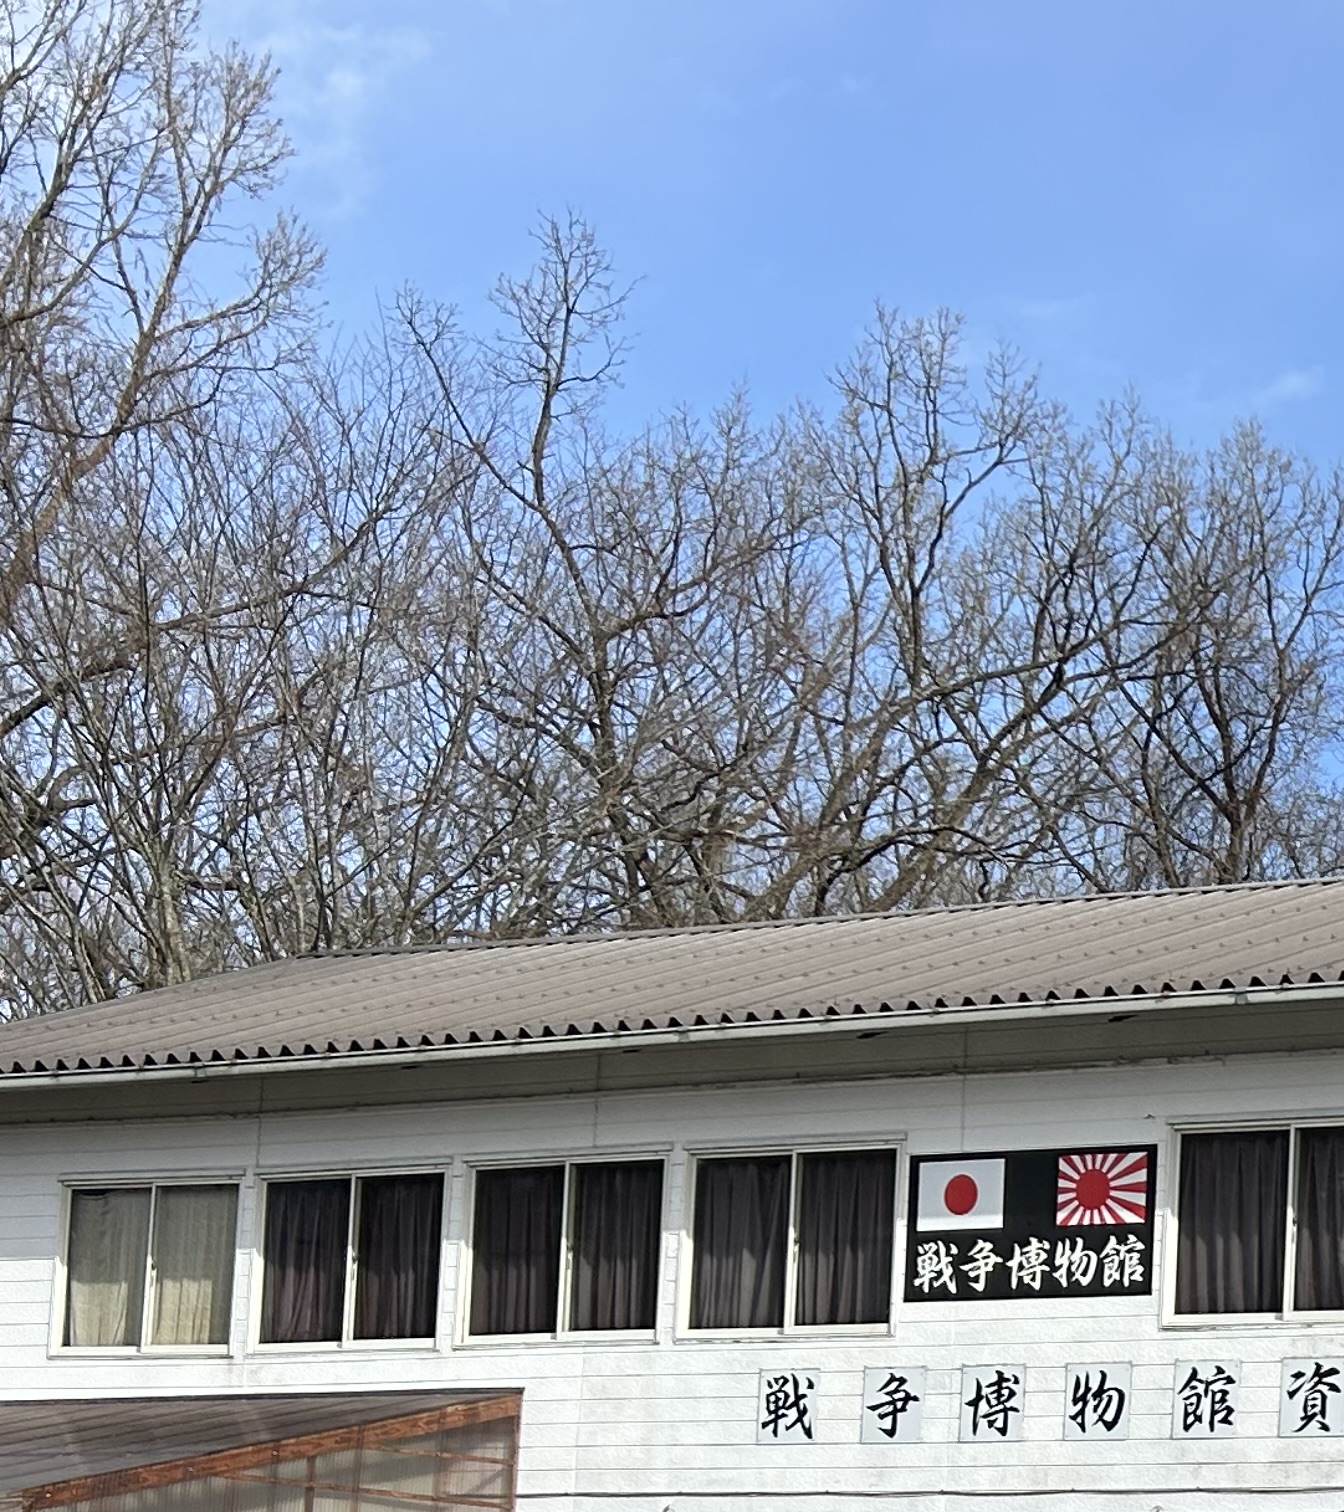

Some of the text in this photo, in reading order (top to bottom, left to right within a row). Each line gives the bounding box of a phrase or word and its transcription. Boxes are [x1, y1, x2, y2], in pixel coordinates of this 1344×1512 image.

[913, 1232, 1146, 1295] 戦争博物館
